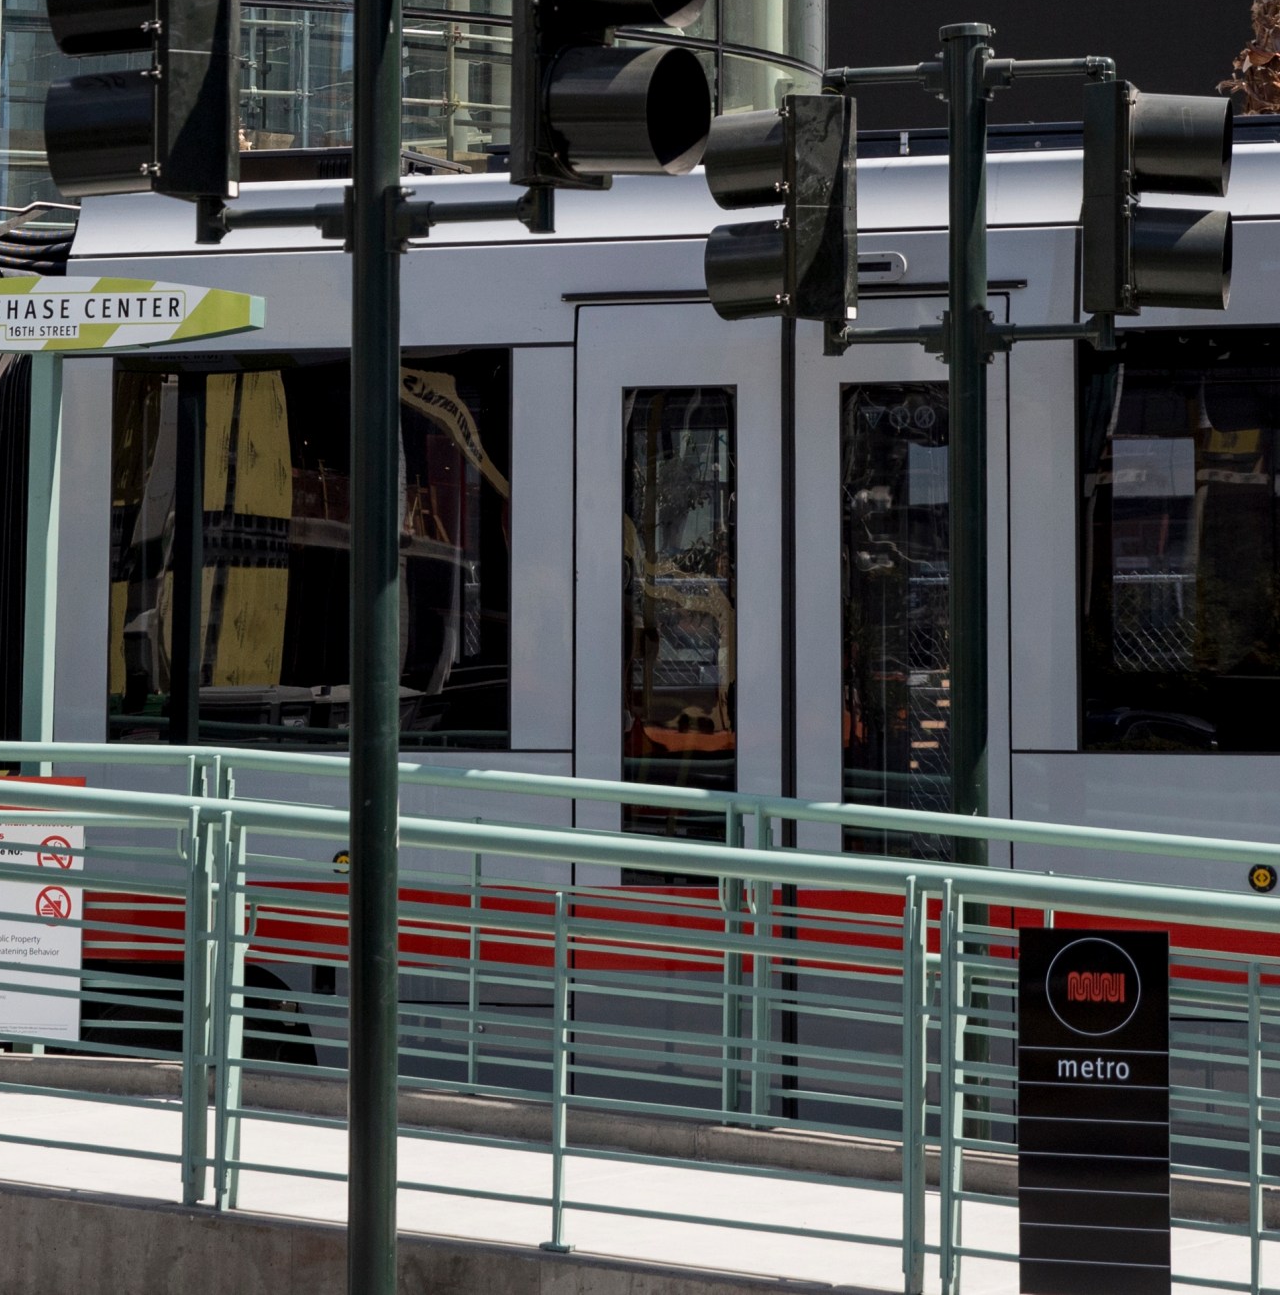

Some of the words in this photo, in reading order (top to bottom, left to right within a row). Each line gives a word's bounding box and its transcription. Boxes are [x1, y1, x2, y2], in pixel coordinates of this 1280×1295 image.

[84, 297, 181, 319] CENTER
[8, 326, 36, 338] 16TH
[39, 325, 78, 337] STREET
[11, 935, 41, 945] Property
[29, 947, 59, 956] Behavior
[1058, 1058, 1130, 1080] metro
